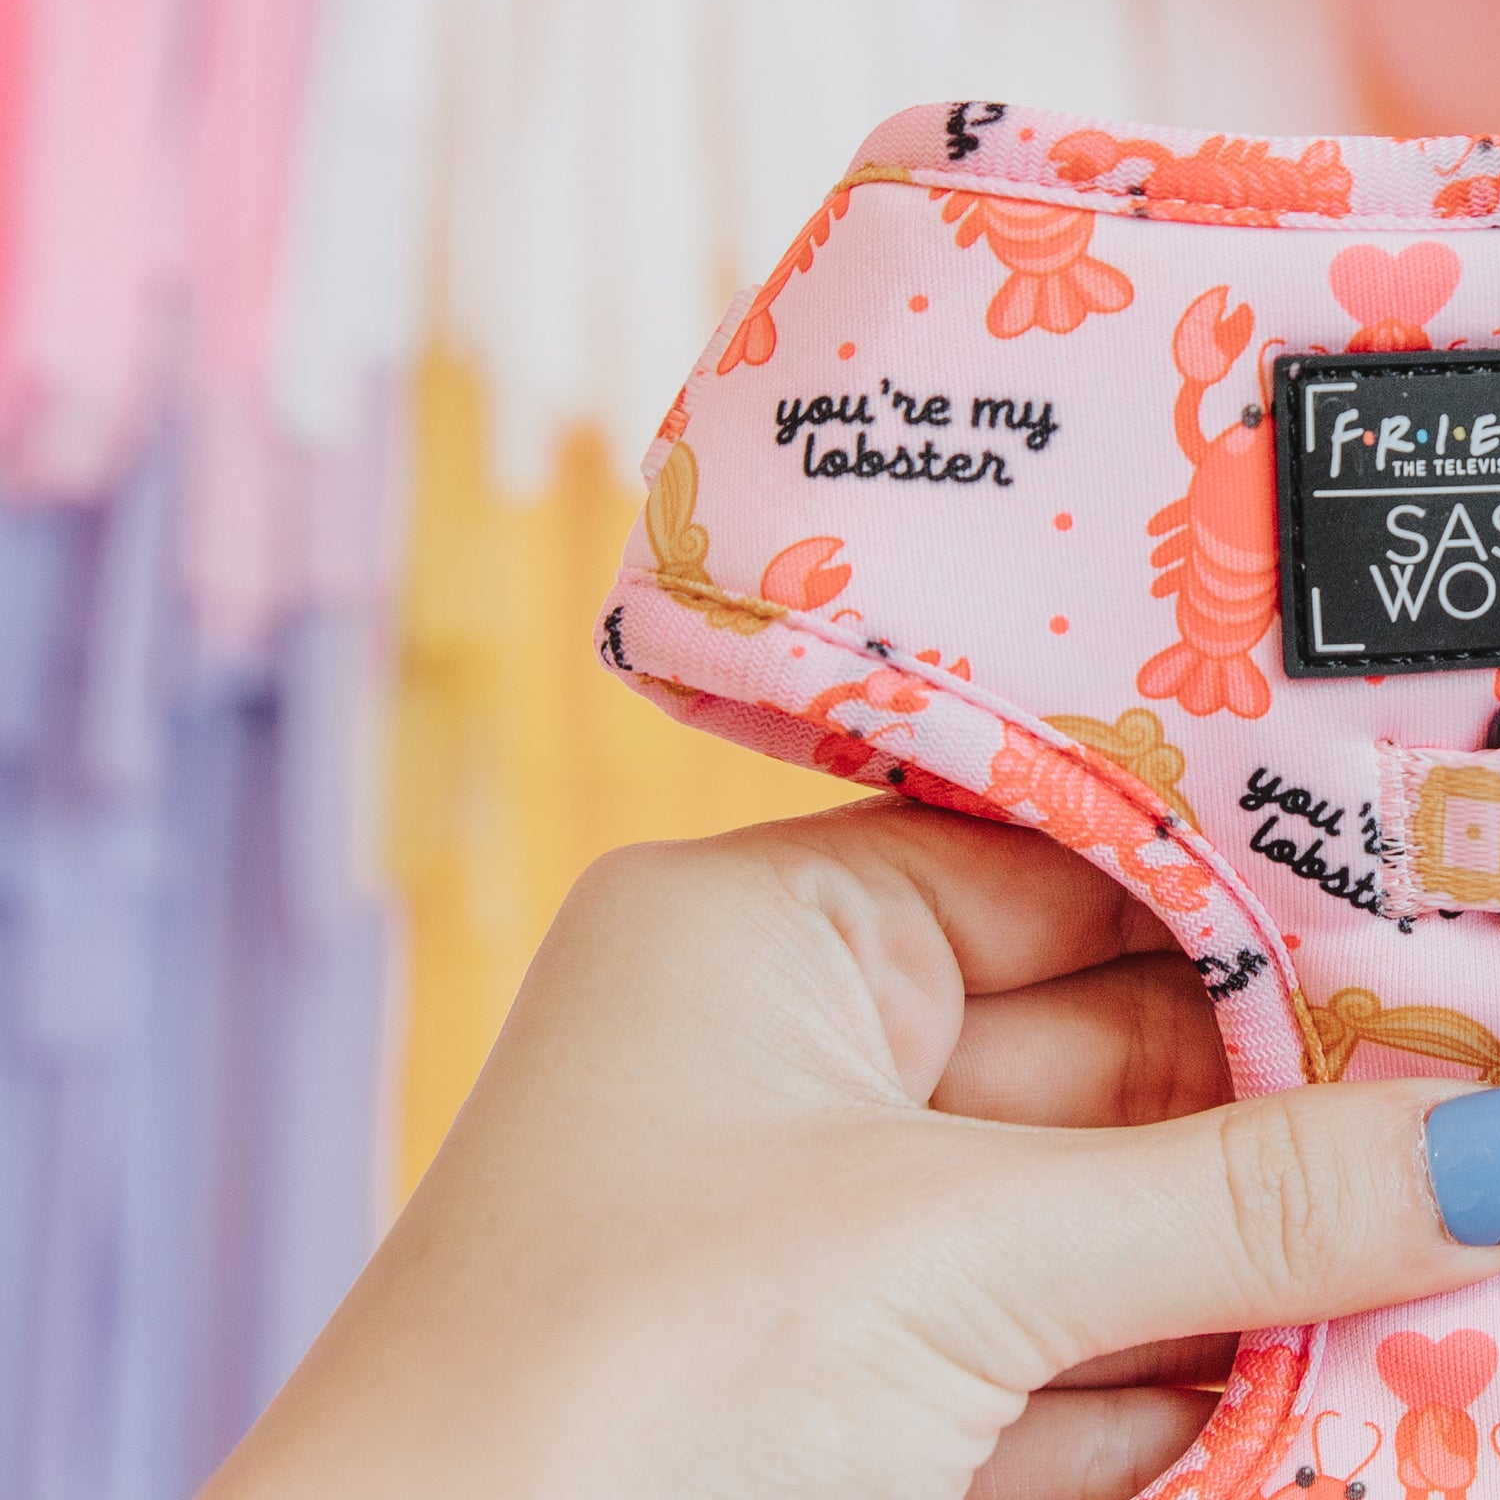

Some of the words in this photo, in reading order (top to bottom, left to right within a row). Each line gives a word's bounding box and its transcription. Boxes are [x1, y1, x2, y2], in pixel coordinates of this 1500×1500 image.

[774, 377, 952, 446] you're
[970, 396, 1060, 451] my
[802, 431, 1014, 487] lobster
[1391, 459, 1428, 477] THE
